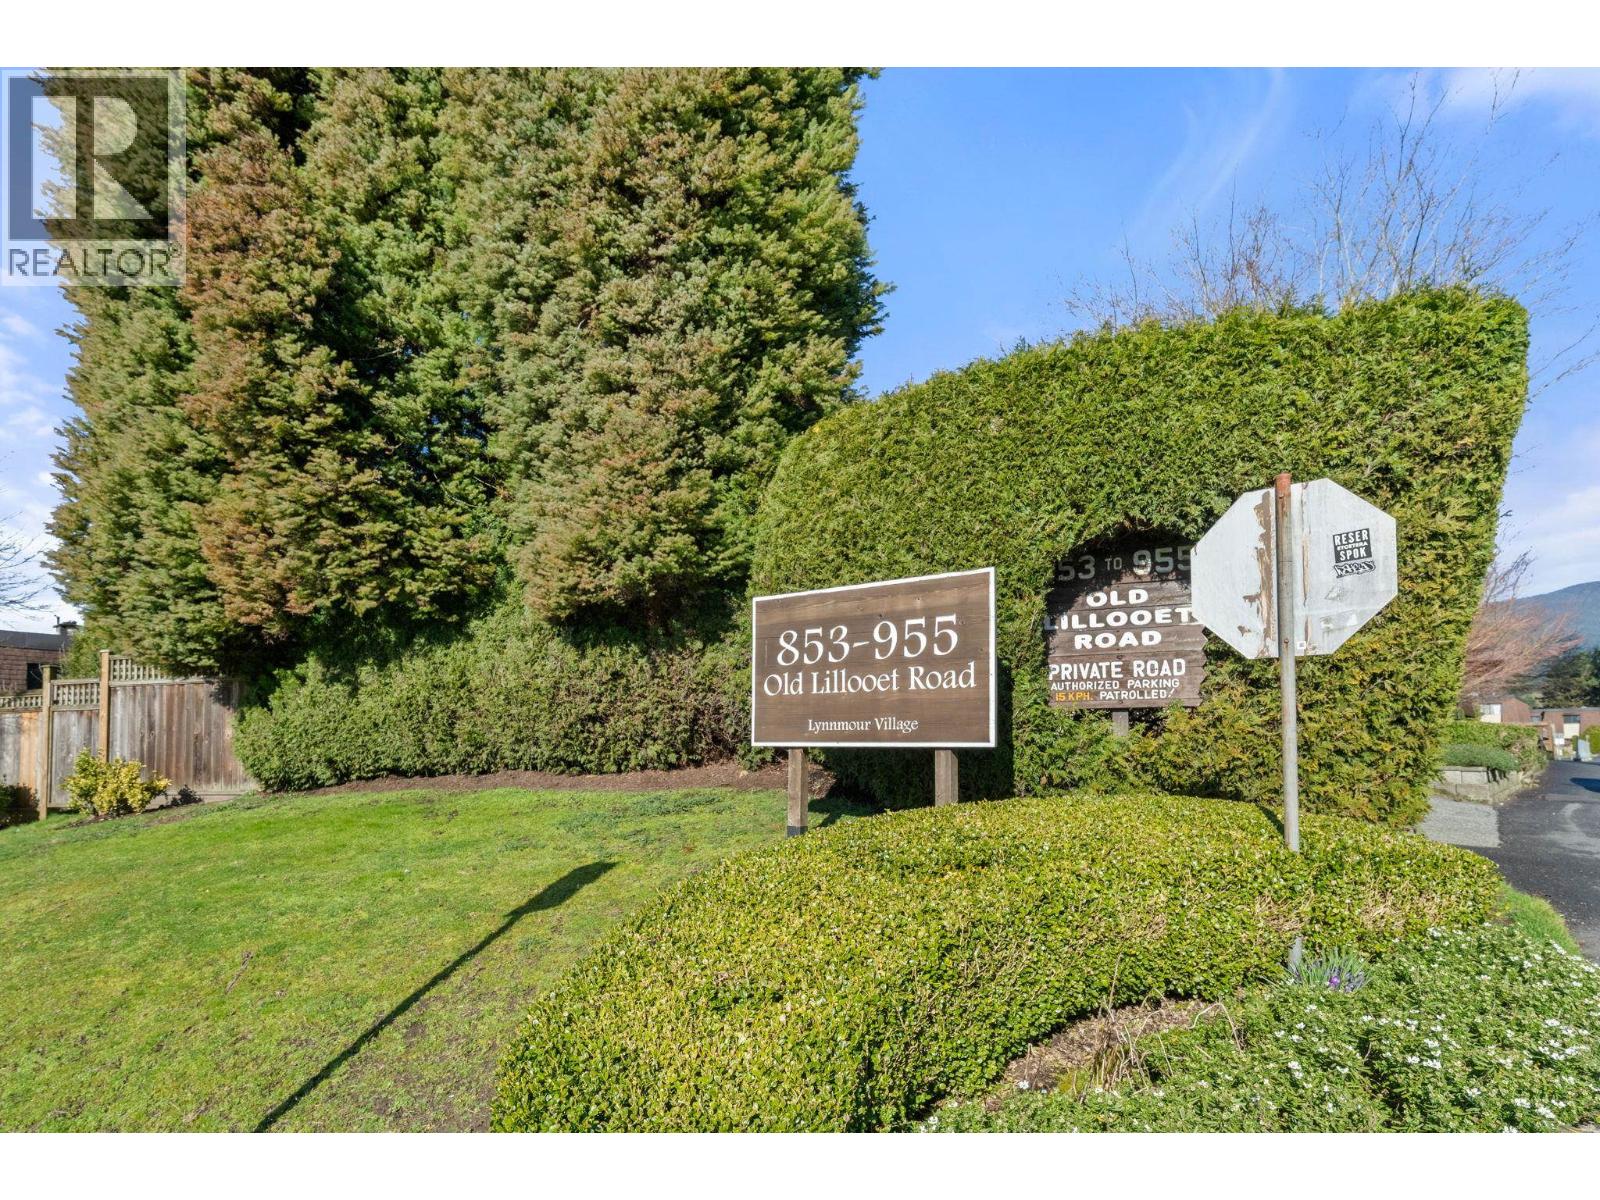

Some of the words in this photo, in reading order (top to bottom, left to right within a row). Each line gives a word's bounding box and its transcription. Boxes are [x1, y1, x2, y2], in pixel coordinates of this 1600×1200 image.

[1334, 529, 1369, 546] RESER
[1340, 546, 1367, 561] SPOK
[1057, 554, 1096, 581] 53
[1105, 556, 1123, 571] TO
[1132, 546, 1191, 576] 955
[1086, 588, 1149, 607] OLD
[1043, 606, 1193, 631] LILLOOET
[776, 613, 959, 666] 853-955
[1074, 630, 1162, 650] ROAD
[763, 671, 804, 696] Old
[811, 668, 900, 694] Lillooet
[908, 661, 977, 690] Road
[1048, 661, 1124, 681] PRIVATE
[1133, 658, 1186, 678] ROAD
[1050, 680, 1120, 691] AUTHORIZED
[1127, 678, 1180, 689] PARKING
[1055, 691, 1066, 702] 15
[1100, 688, 1175, 701] PATROLLED!
[808, 719, 872, 734] Lynnmour
[874, 717, 919, 734] Village
